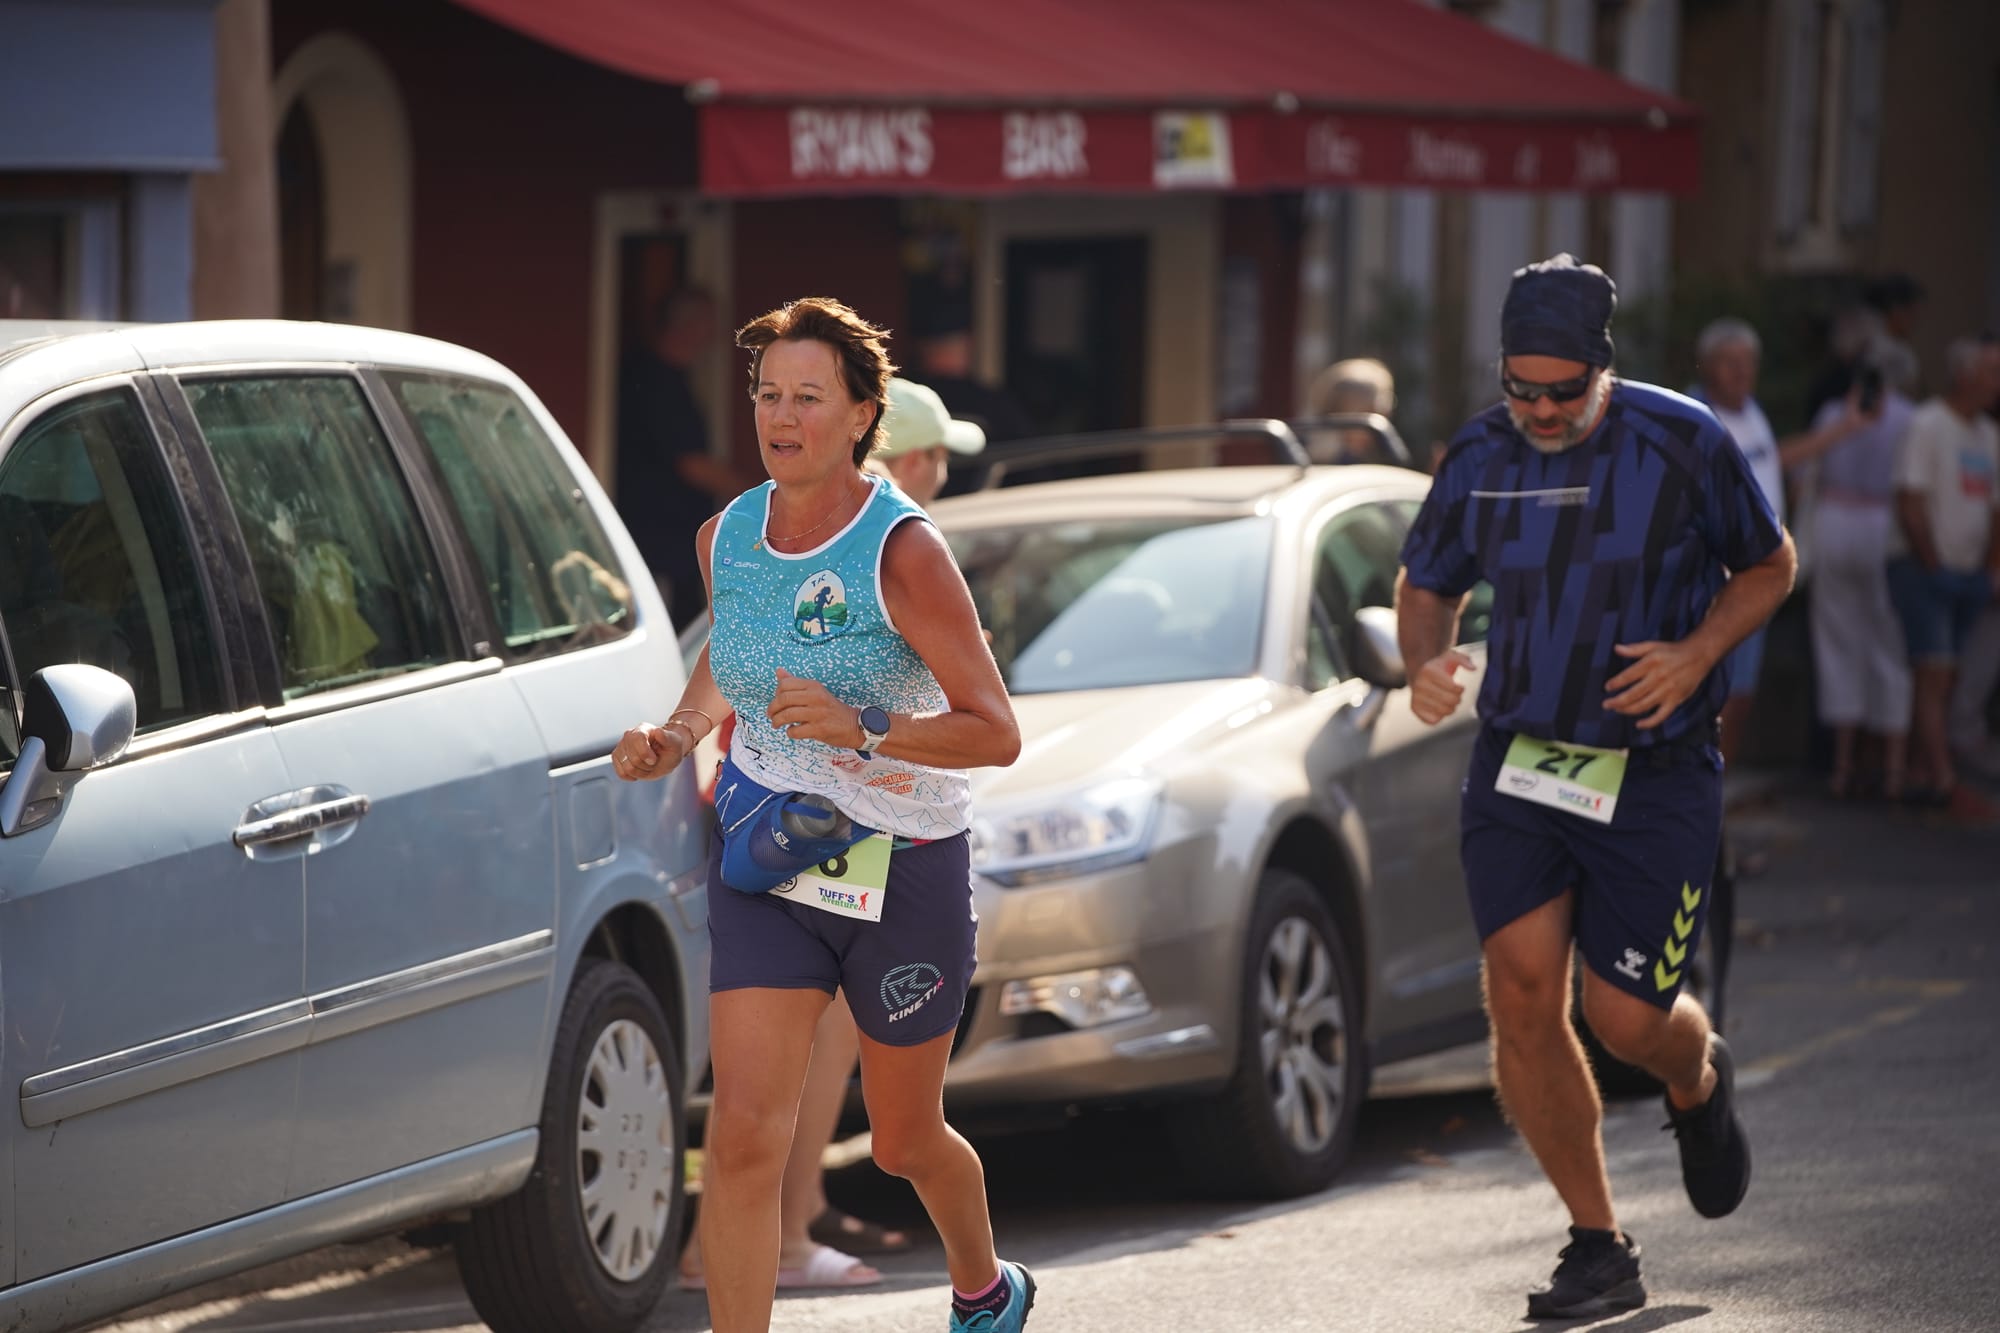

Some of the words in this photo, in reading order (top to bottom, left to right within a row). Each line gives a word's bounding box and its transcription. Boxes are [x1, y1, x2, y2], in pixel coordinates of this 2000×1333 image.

[1002, 109, 1090, 179] BAR
[1535, 746, 1598, 780] 27
[819, 848, 849, 878] 6
[818, 887, 856, 904] TUFF'S
[821, 895, 859, 911] Aventure
